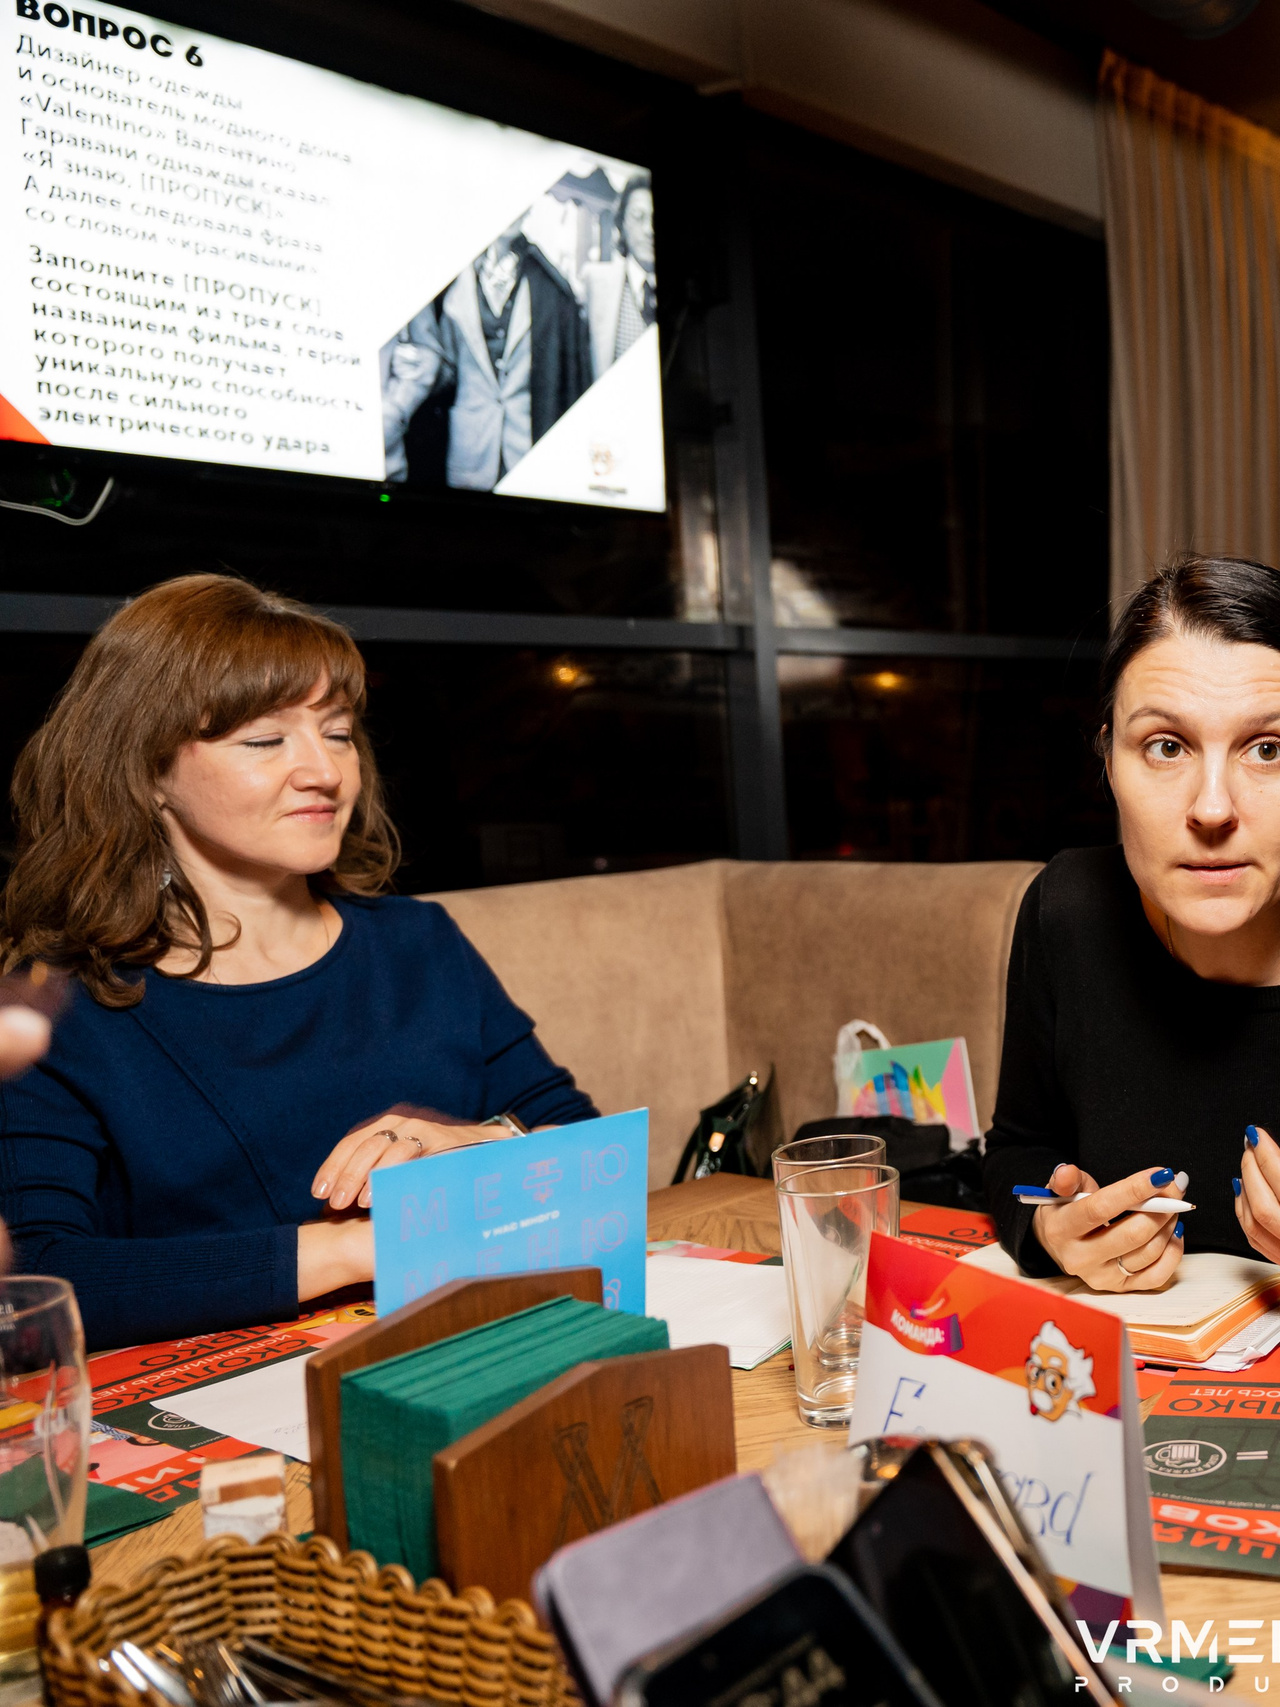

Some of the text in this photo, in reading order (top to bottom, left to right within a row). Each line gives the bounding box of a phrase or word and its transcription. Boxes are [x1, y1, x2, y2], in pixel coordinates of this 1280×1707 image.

[15, 0, 204, 68] ВОПРОС 6
[16, 34, 242, 110] Дизайнер одежды
[18, 66, 32, 81] и
[42, 73, 186, 121] основатель
[194, 113, 290, 147] модного
[22, 117, 138, 161] Гаравани
[146, 154, 254, 188] однажды
[176, 129, 296, 173] Валентино
[24, 175, 39, 194] А
[49, 185, 121, 212] далее
[131, 203, 252, 238] следовала
[25, 206, 55, 223] со
[65, 214, 157, 243] словом
[29, 244, 174, 287] Заполните
[30, 276, 343, 341] состоящим из трех слов
[32, 302, 178, 337] названием
[34, 329, 286, 378] которого получает
[35, 354, 363, 411] уникальную способность
[36, 381, 247, 419] после сильного
[38, 407, 254, 445] электрического
[131, 1334, 292, 1387] ИСПОЛНИЛОСЬ
[1189, 1388, 1233, 1398] ЛЕТ
